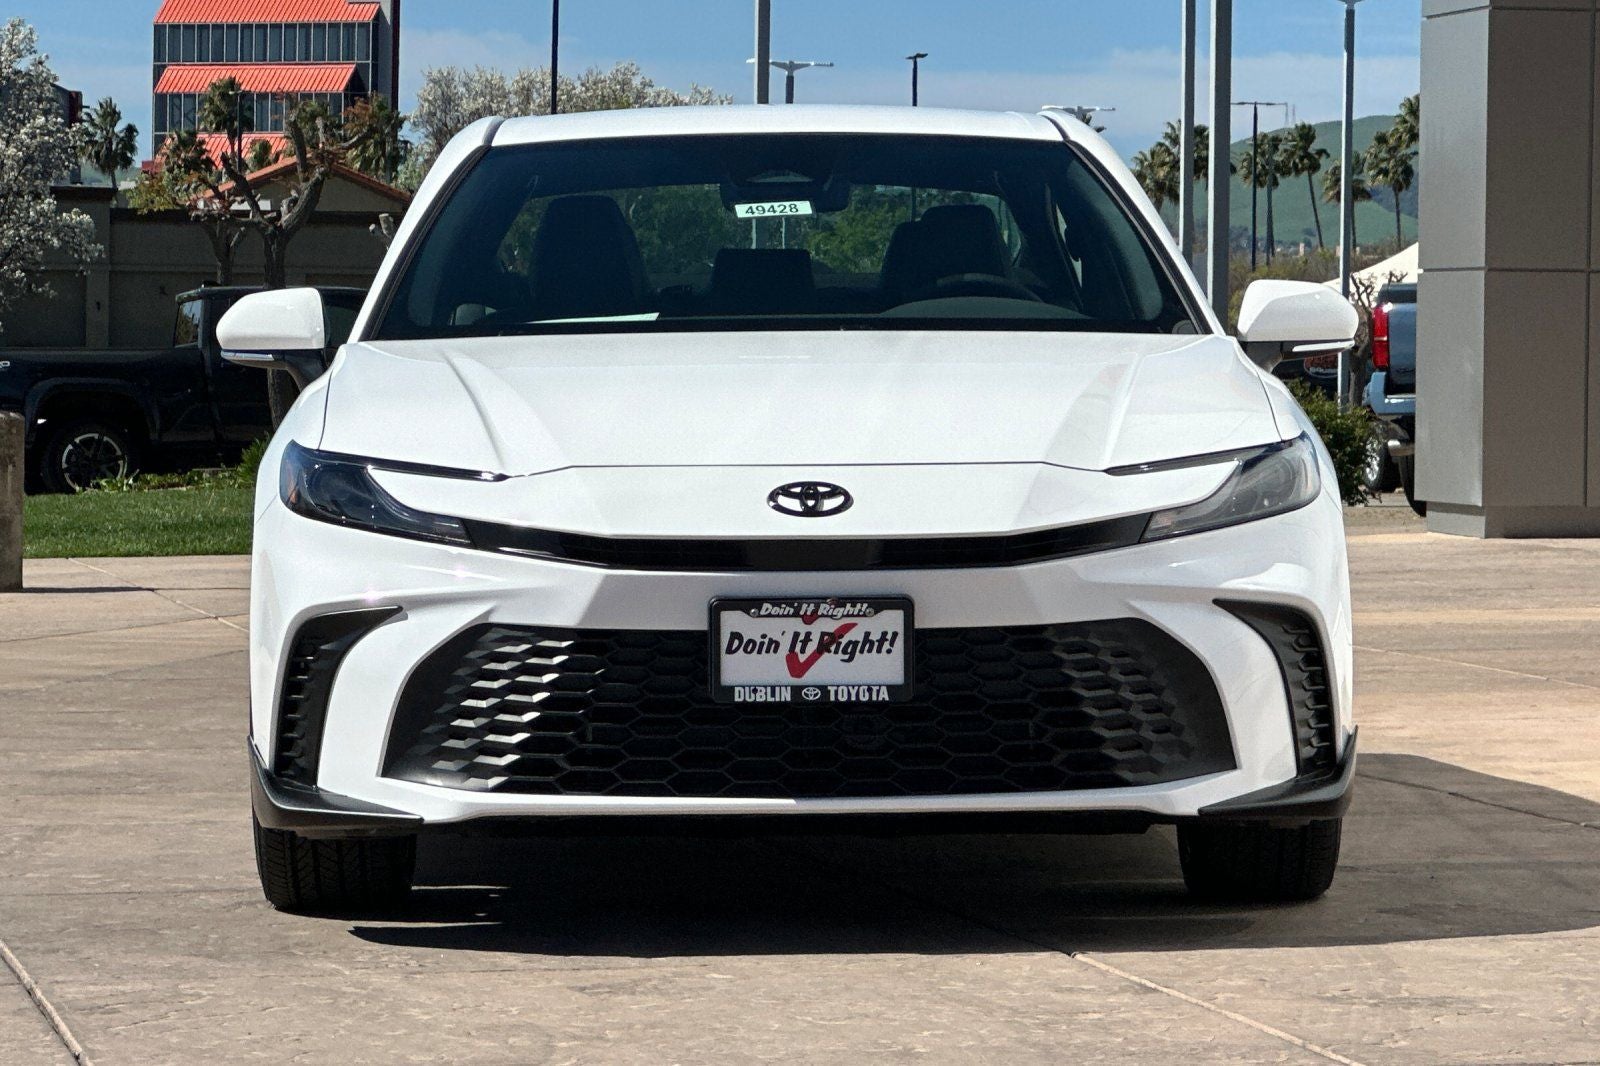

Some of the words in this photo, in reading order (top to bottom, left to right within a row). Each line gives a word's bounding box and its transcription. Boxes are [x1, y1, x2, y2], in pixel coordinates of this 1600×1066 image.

[745, 203, 799, 215] 49428
[759, 602, 798, 615] Doin'
[800, 602, 815, 615] It
[818, 602, 867, 620] Right!
[725, 630, 785, 655] Doin'
[789, 631, 812, 654] It
[816, 631, 898, 662] Right!
[734, 686, 791, 701] DUBLIN
[828, 686, 889, 701] TOYOTA
